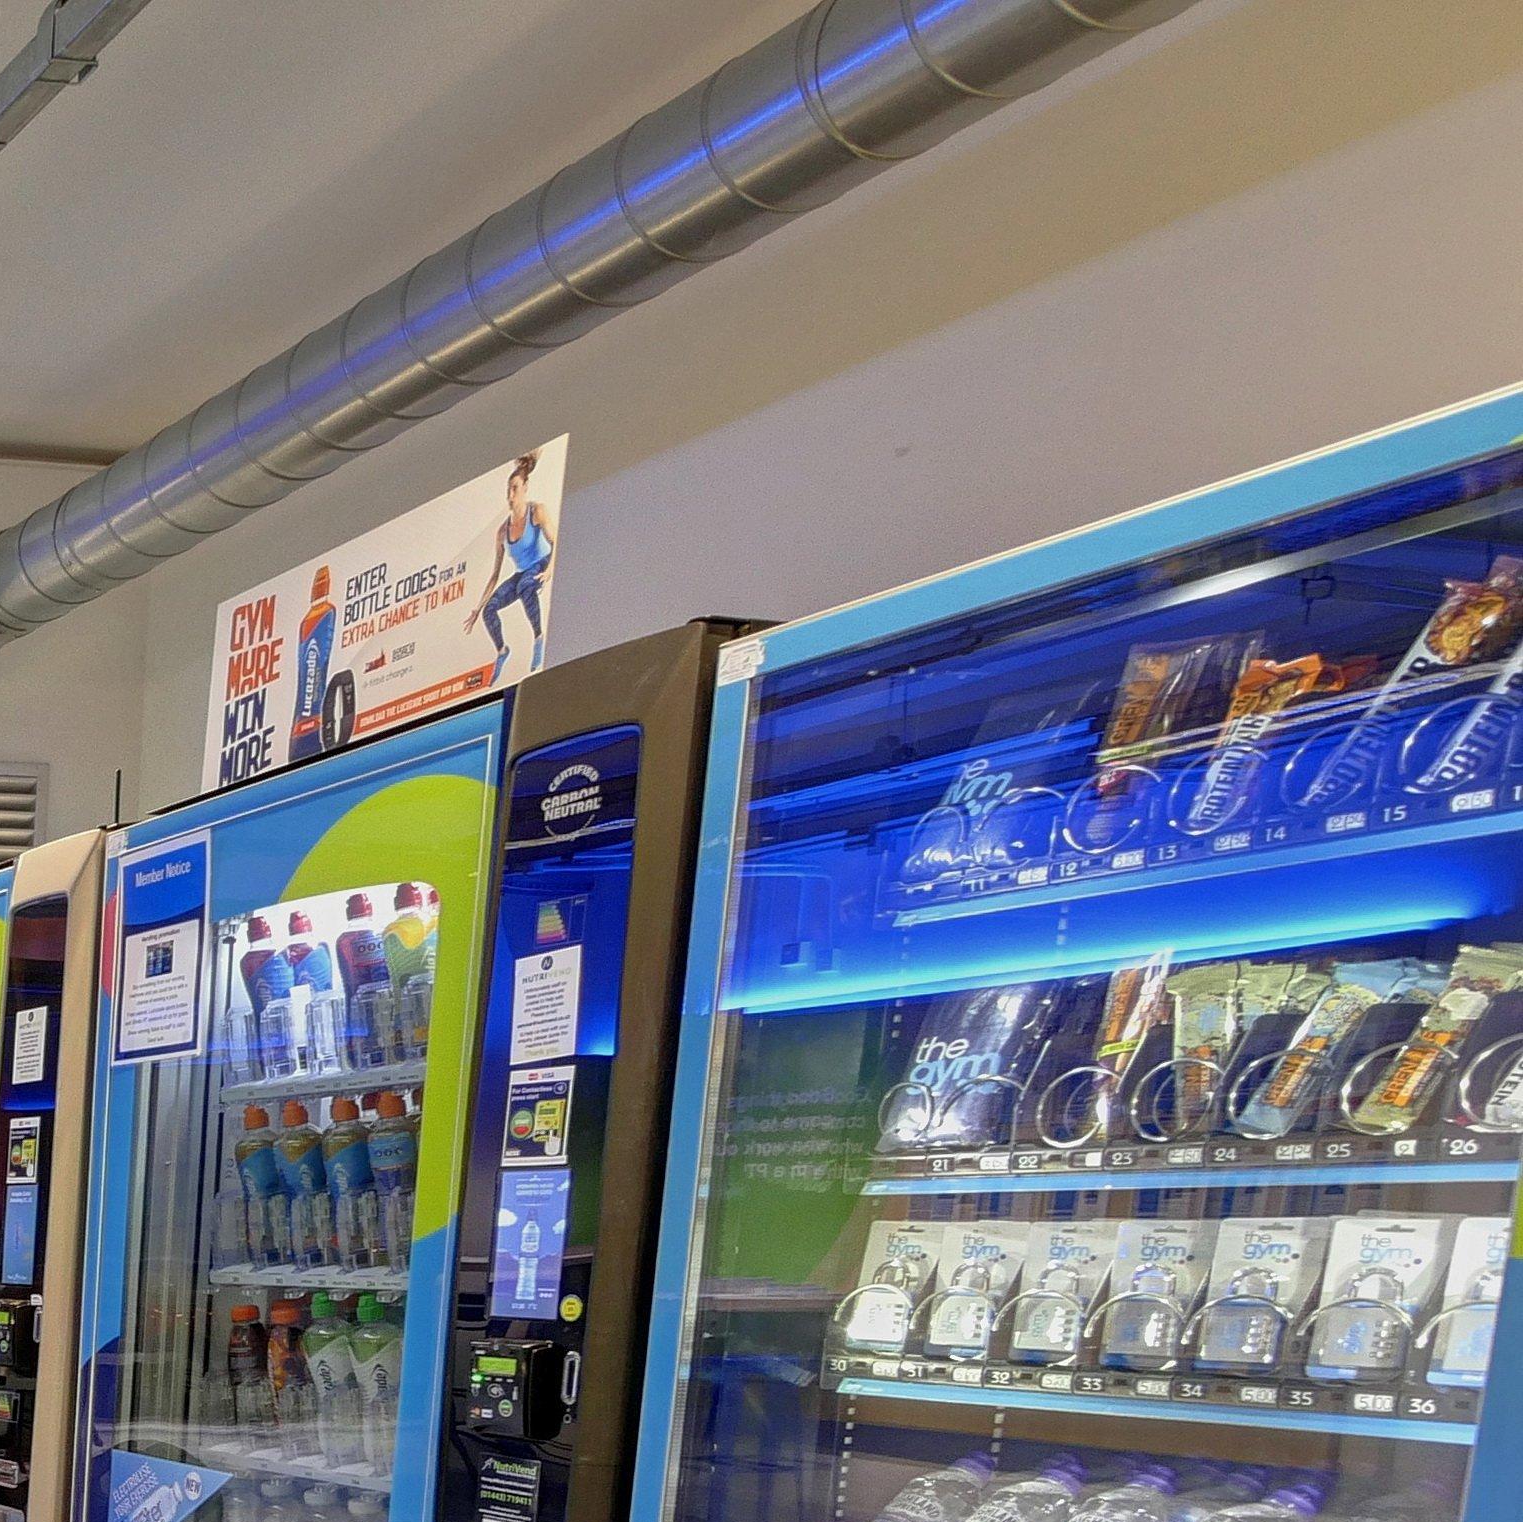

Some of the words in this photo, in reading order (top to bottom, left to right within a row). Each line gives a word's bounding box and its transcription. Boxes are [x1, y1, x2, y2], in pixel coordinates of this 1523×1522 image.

[346, 562, 387, 600] ENTER
[344, 585, 392, 627] BOTTLE
[395, 564, 437, 602] CODES
[439, 567, 454, 585] FOR
[456, 561, 467, 575] AN
[341, 618, 375, 648] EXTRA
[378, 598, 420, 632] CHANCE
[425, 591, 438, 613] TO
[442, 579, 466, 606] WIN
[230, 594, 276, 651] GYM
[302, 649, 318, 717] Lucozade
[223, 688, 267, 748] WIN
[219, 726, 275, 787] MORE
[548, 764, 599, 792] CERTIFIED
[541, 785, 600, 811] CARBON
[1383, 806, 1407, 822] 15
[1264, 826, 1286, 841] 14
[1158, 848, 1177, 860] 13
[135, 868, 164, 888] Member
[165, 861, 191, 879] Notice
[1059, 863, 1077, 877] 12
[915, 1036, 970, 1063] the
[909, 1051, 1003, 1095] gym
[1213, 1148, 1237, 1162] 24
[1326, 1144, 1352, 1158] 25
[1449, 1140, 1478, 1156] 26
[932, 1160, 949, 1171] 21
[1017, 1156, 1039, 1168] 22
[1111, 1152, 1133, 1165] 23
[887, 1232, 908, 1245] the
[963, 1233, 984, 1245] the
[1051, 1234, 1073, 1246] the
[1141, 1234, 1167, 1247] the
[1243, 1231, 1272, 1245] the
[1361, 1234, 1391, 1248] the
[886, 1244, 922, 1259] gym
[962, 1244, 1000, 1260] gym
[1049, 1245, 1090, 1260] gym
[1141, 1244, 1187, 1262] gym
[1242, 1243, 1291, 1260] gym
[1359, 1246, 1413, 1263] gym
[829, 1359, 847, 1371] 30
[990, 1371, 1010, 1384] 32
[1082, 1378, 1102, 1390] 33
[1179, 1382, 1202, 1399] 34
[1287, 1390, 1314, 1406] 35
[1407, 1398, 1435, 1414] 36
[493, 1461, 537, 1476] NutriVend
[185, 1477, 199, 1495] NEW
